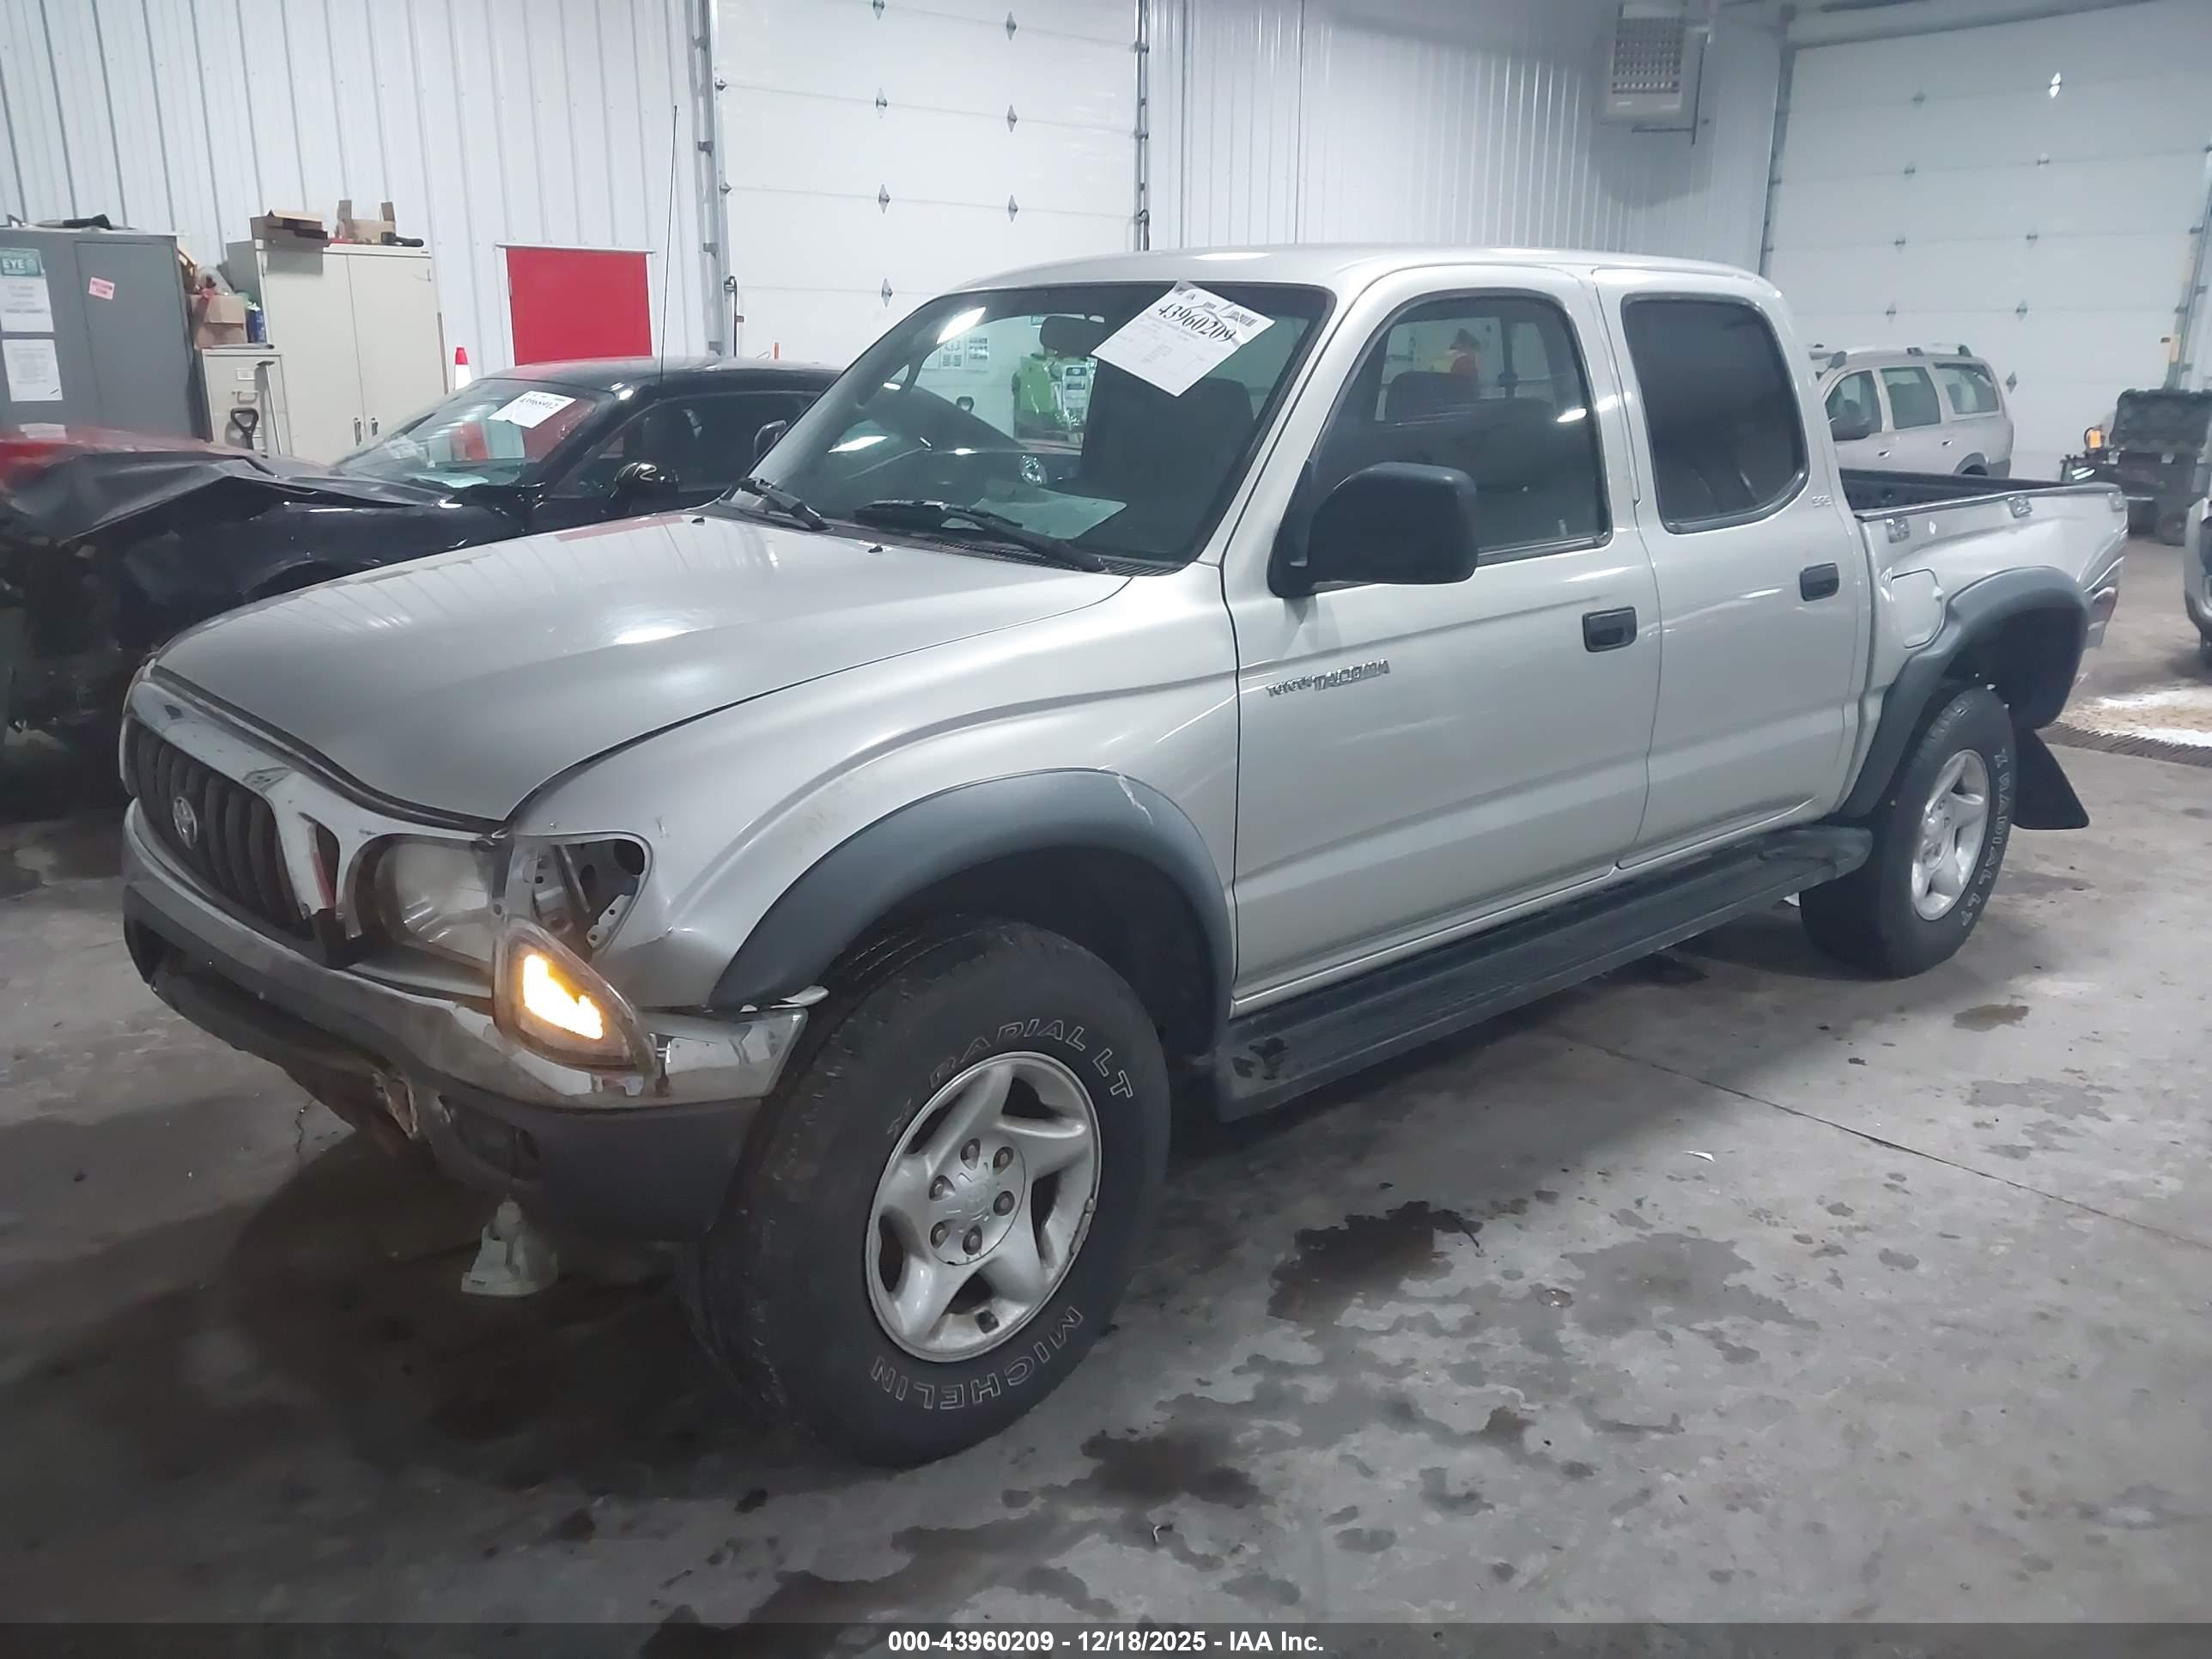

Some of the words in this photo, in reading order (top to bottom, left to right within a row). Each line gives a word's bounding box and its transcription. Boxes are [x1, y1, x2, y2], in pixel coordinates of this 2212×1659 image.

[2, 258, 26, 269] EYE
[1158, 302, 1237, 343] 43960209
[1091, 1048, 1134, 1099] LT
[871, 1305, 1085, 1409] MICHELIN
